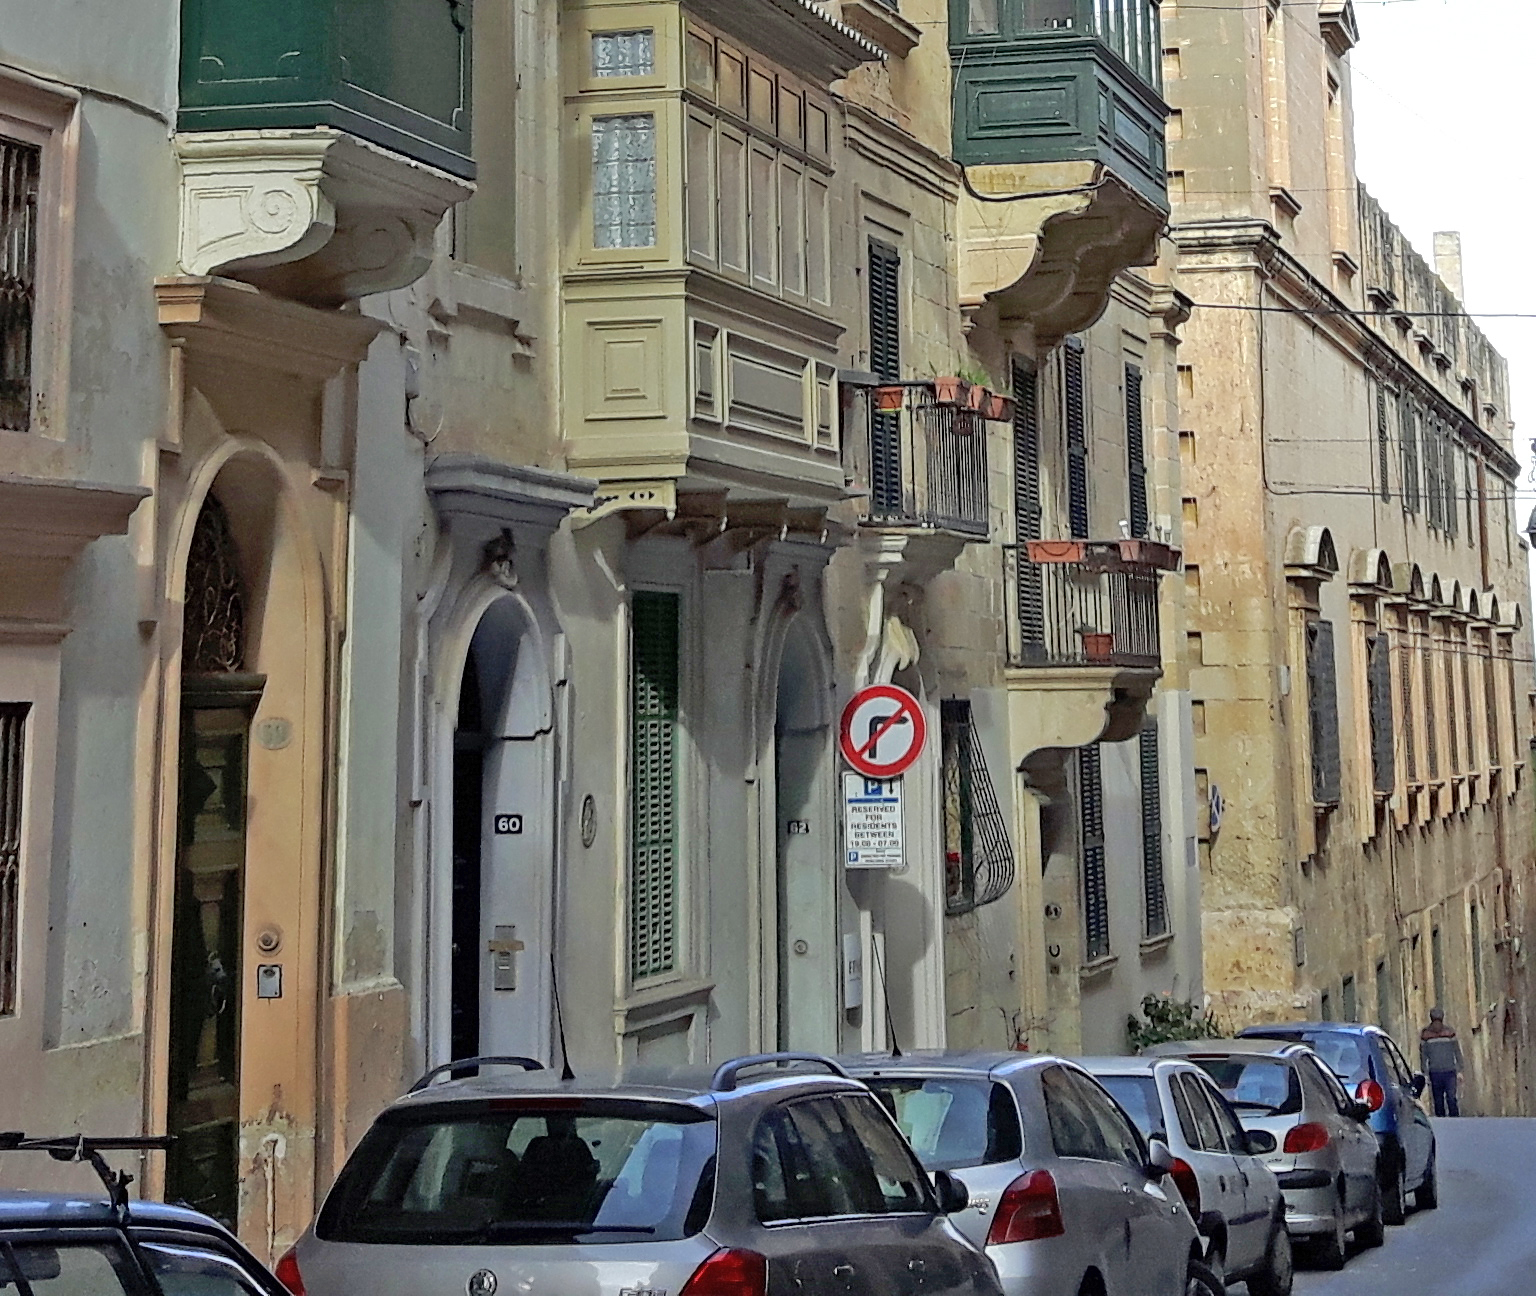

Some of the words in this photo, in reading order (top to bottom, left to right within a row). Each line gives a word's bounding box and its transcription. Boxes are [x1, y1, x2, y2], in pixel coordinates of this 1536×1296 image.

[498, 817, 520, 832] 60
[790, 822, 807, 834] 62
[850, 822, 897, 830] RESIDENTS
